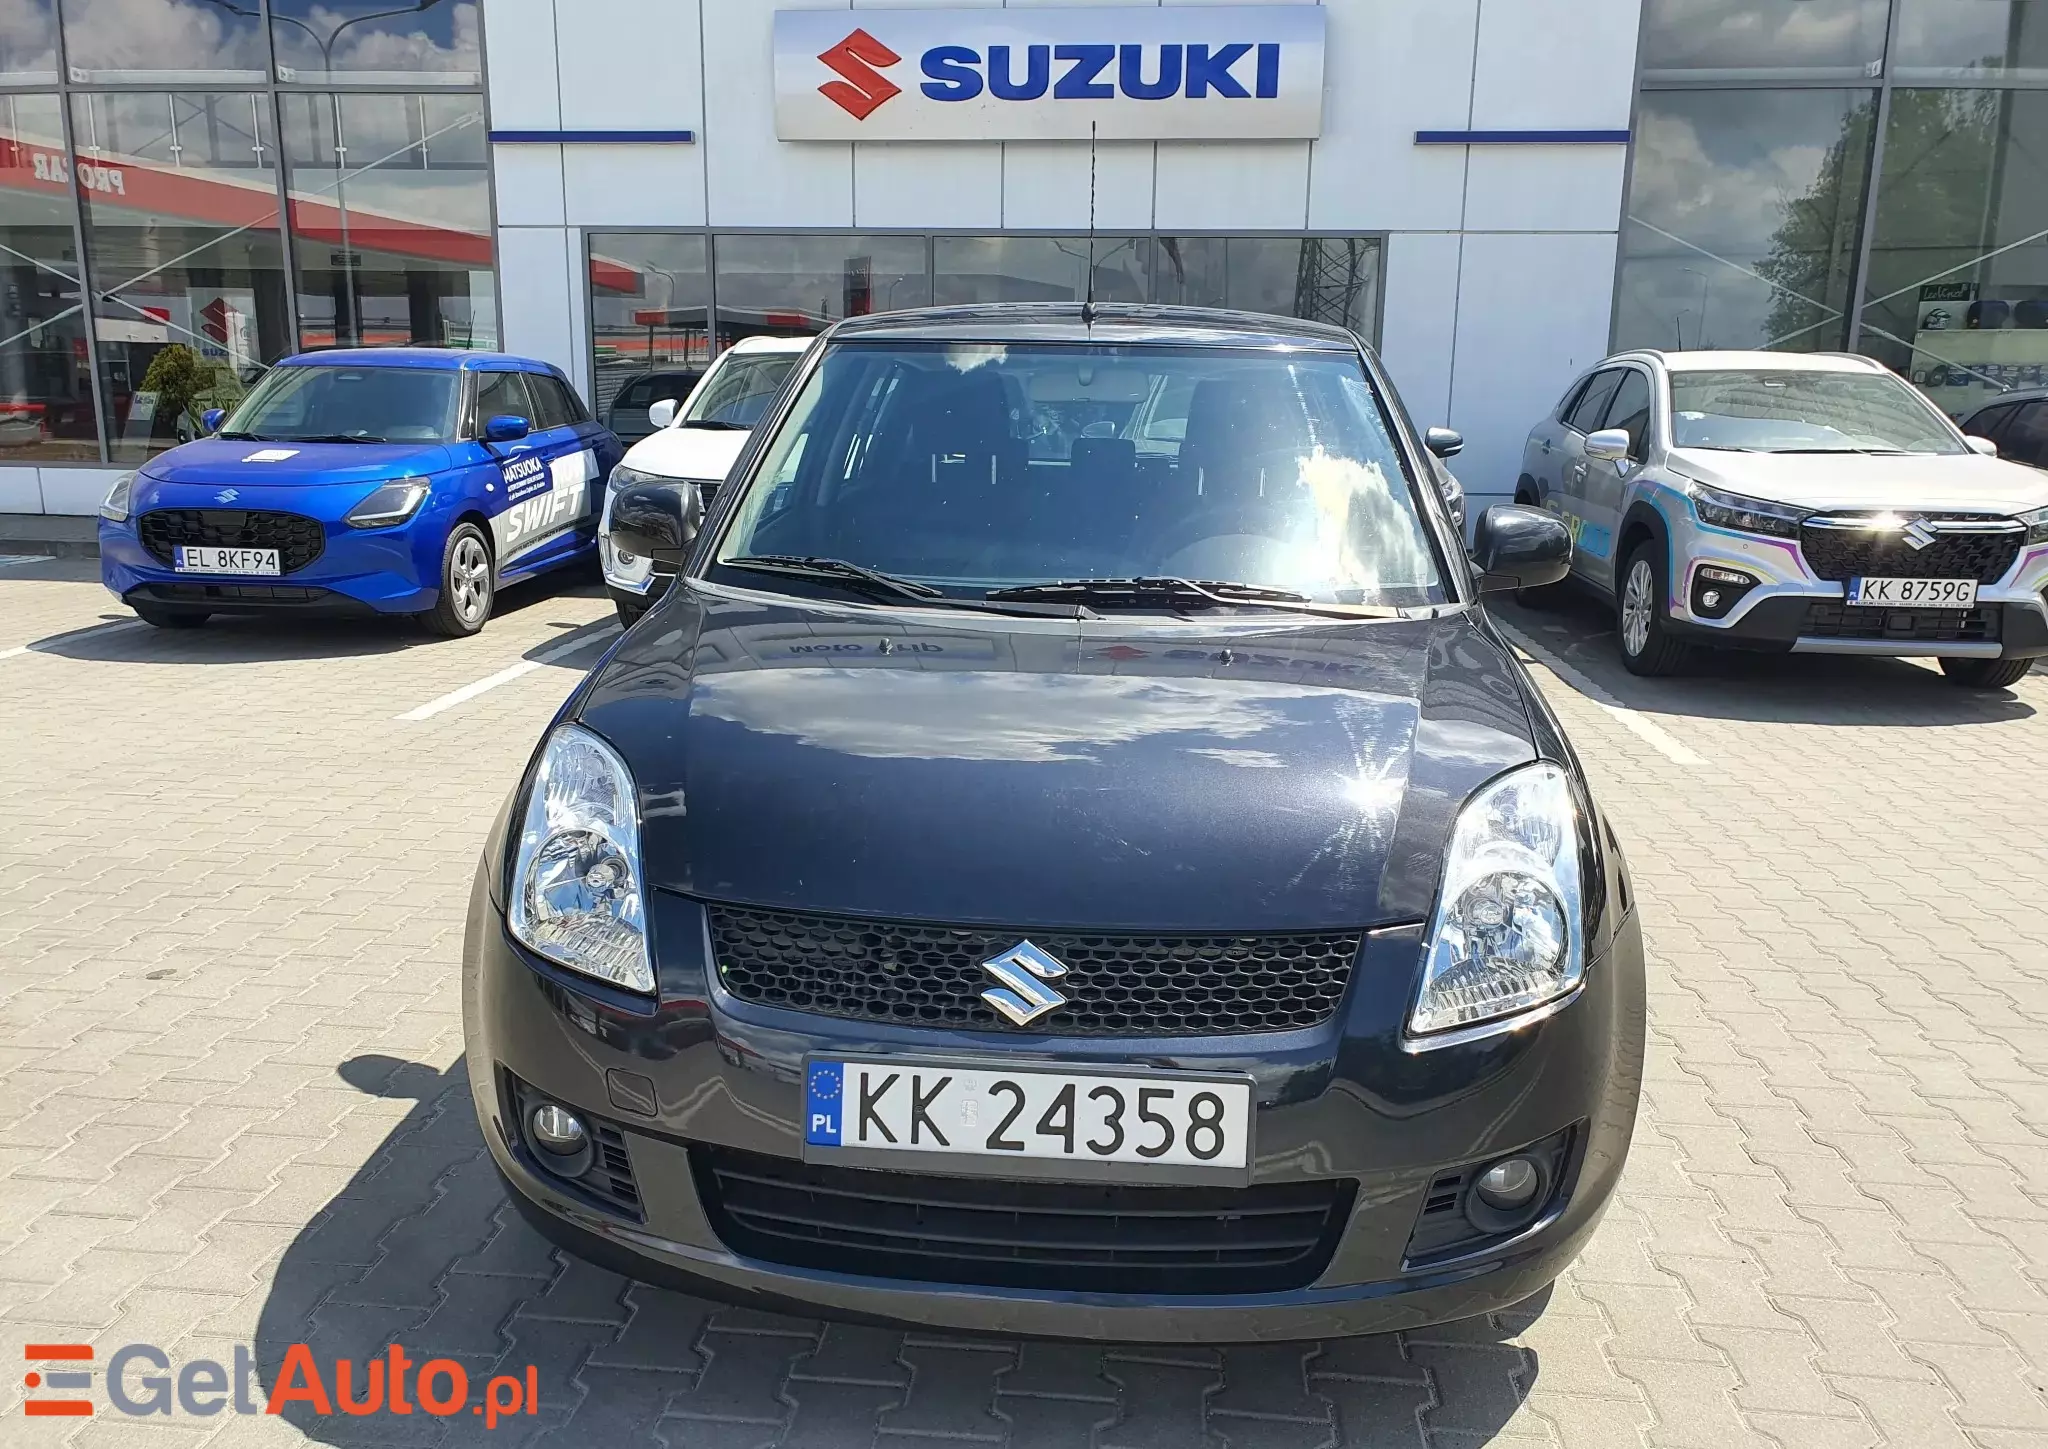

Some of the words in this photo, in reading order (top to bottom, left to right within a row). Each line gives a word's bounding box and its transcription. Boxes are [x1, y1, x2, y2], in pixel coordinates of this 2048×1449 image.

[920, 43, 1281, 102] SUZUKI
[501, 456, 543, 484] MATSUOKA
[506, 482, 586, 543] SWIFT
[186, 548, 211, 568] EL
[217, 549, 276, 570] 8KF94
[1863, 579, 1894, 600] KK
[1900, 581, 1971, 602] 8759G
[812, 1114, 837, 1134] PL
[858, 1071, 953, 1147] KK
[985, 1080, 1226, 1161] 24358
